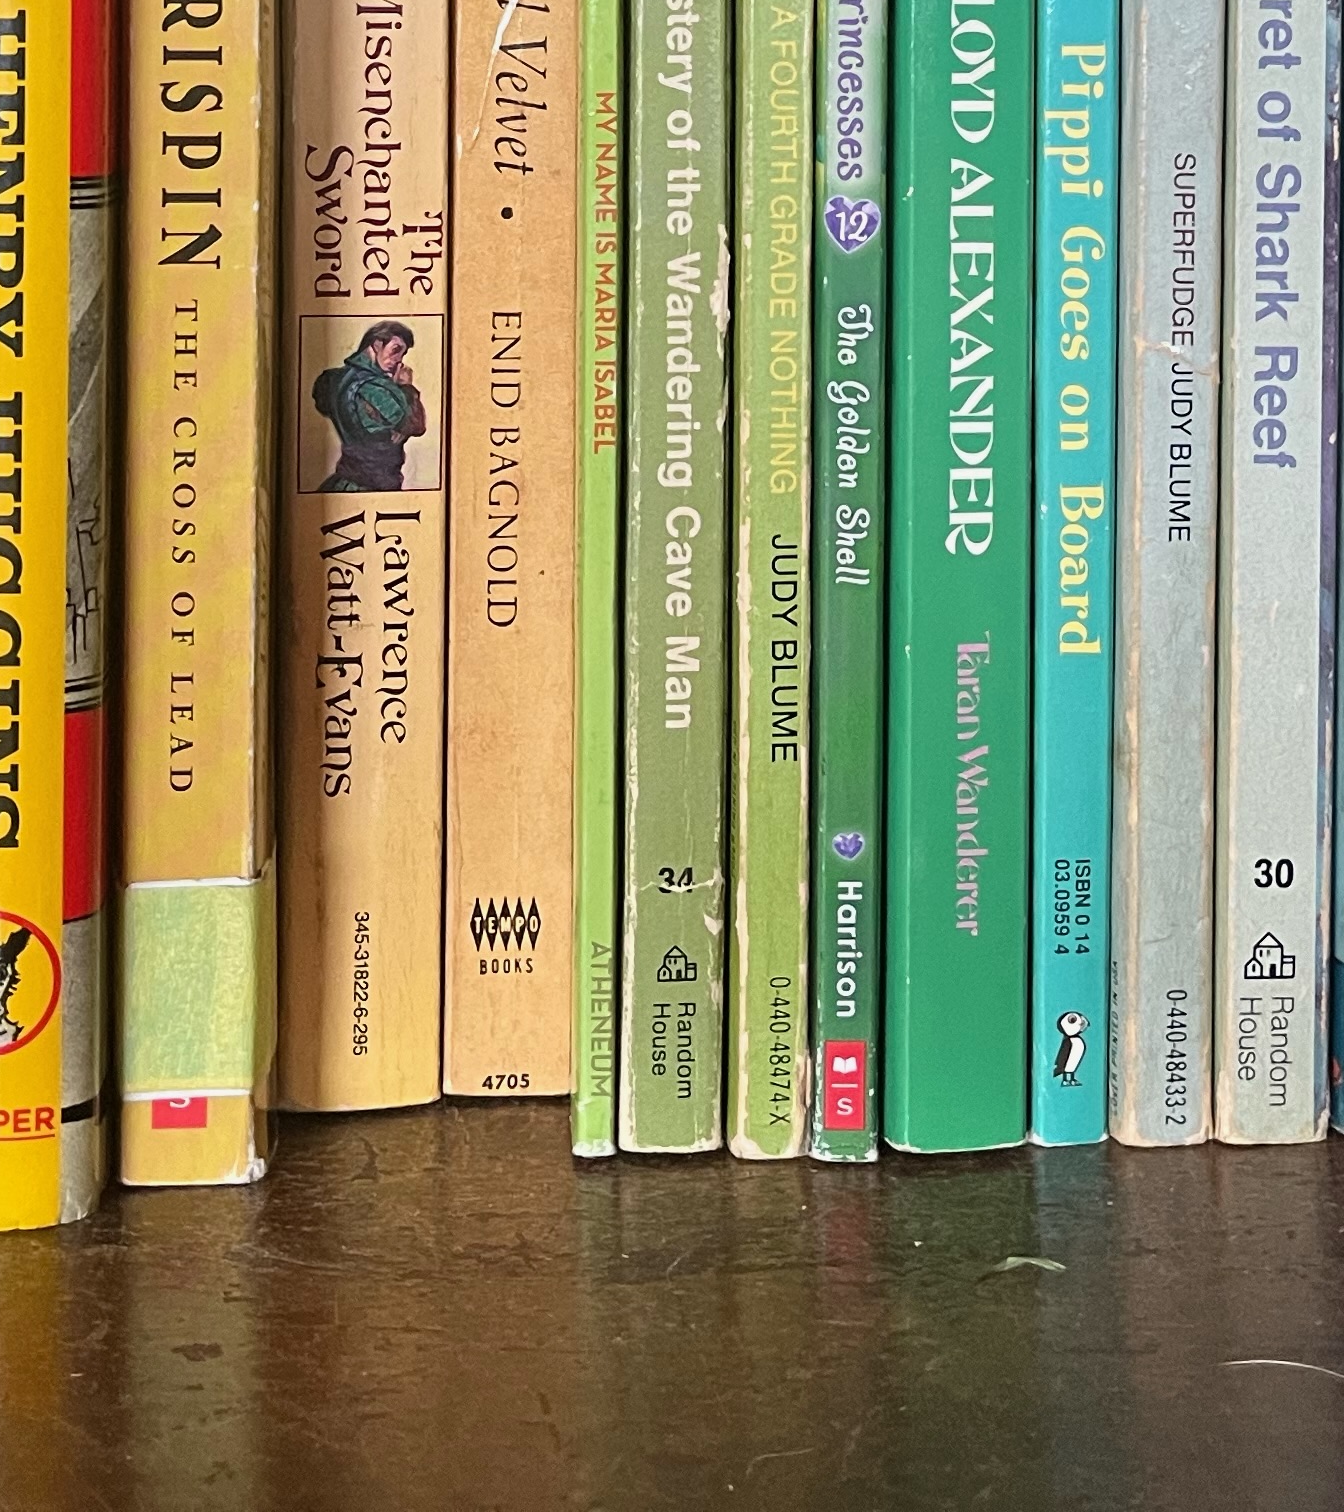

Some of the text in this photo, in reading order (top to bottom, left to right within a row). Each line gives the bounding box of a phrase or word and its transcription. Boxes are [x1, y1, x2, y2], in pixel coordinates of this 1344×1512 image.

[770, 7, 798, 29] A
[494, 38, 548, 176] Velvet
[666, 110, 701, 151] of
[769, 40, 798, 183] FOURTH
[1257, 91, 1301, 141] of
[304, 144, 353, 299] Sword
[402, 211, 443, 296] The
[666, 168, 701, 235] the
[769, 195, 797, 318] GRADE
[838, 212, 868, 240] 12
[1254, 163, 1302, 322] Shark
[173, 299, 199, 391] THE
[657, 253, 701, 488] Wandering
[945, 158, 995, 556] ALEXANDER
[1042, 43, 1106, 656] Pippi Goes on Board
[1168, 153, 1196, 541] SUPERFUDGE JUDY BLUME
[1253, 346, 1298, 468] Reef
[487, 311, 522, 628] ENID BAGNOLD
[769, 331, 797, 493] NOTHING
[827, 304, 874, 585] The Golden Shell
[170, 417, 197, 564] CROSS
[169, 592, 196, 647] OF
[665, 506, 701, 616] Cave
[318, 510, 365, 798] Watt-Evans
[374, 510, 422, 744] Lawrence
[665, 637, 699, 729] Man
[771, 535, 798, 763] JUDY BLUME
[169, 673, 196, 793] LEAD
[955, 631, 991, 937] Taran Wanderer
[658, 867, 695, 893] 34
[1255, 858, 1294, 888] 30
[835, 881, 863, 1018] Harrison
[589, 942, 612, 1098] ATHENEUM
[651, 1003, 671, 1076] House
[676, 1003, 695, 1099] Random
[1164, 990, 1188, 1125] 0-440-48433-2
[1238, 997, 1263, 1081] House
[1267, 996, 1295, 1106] Random
